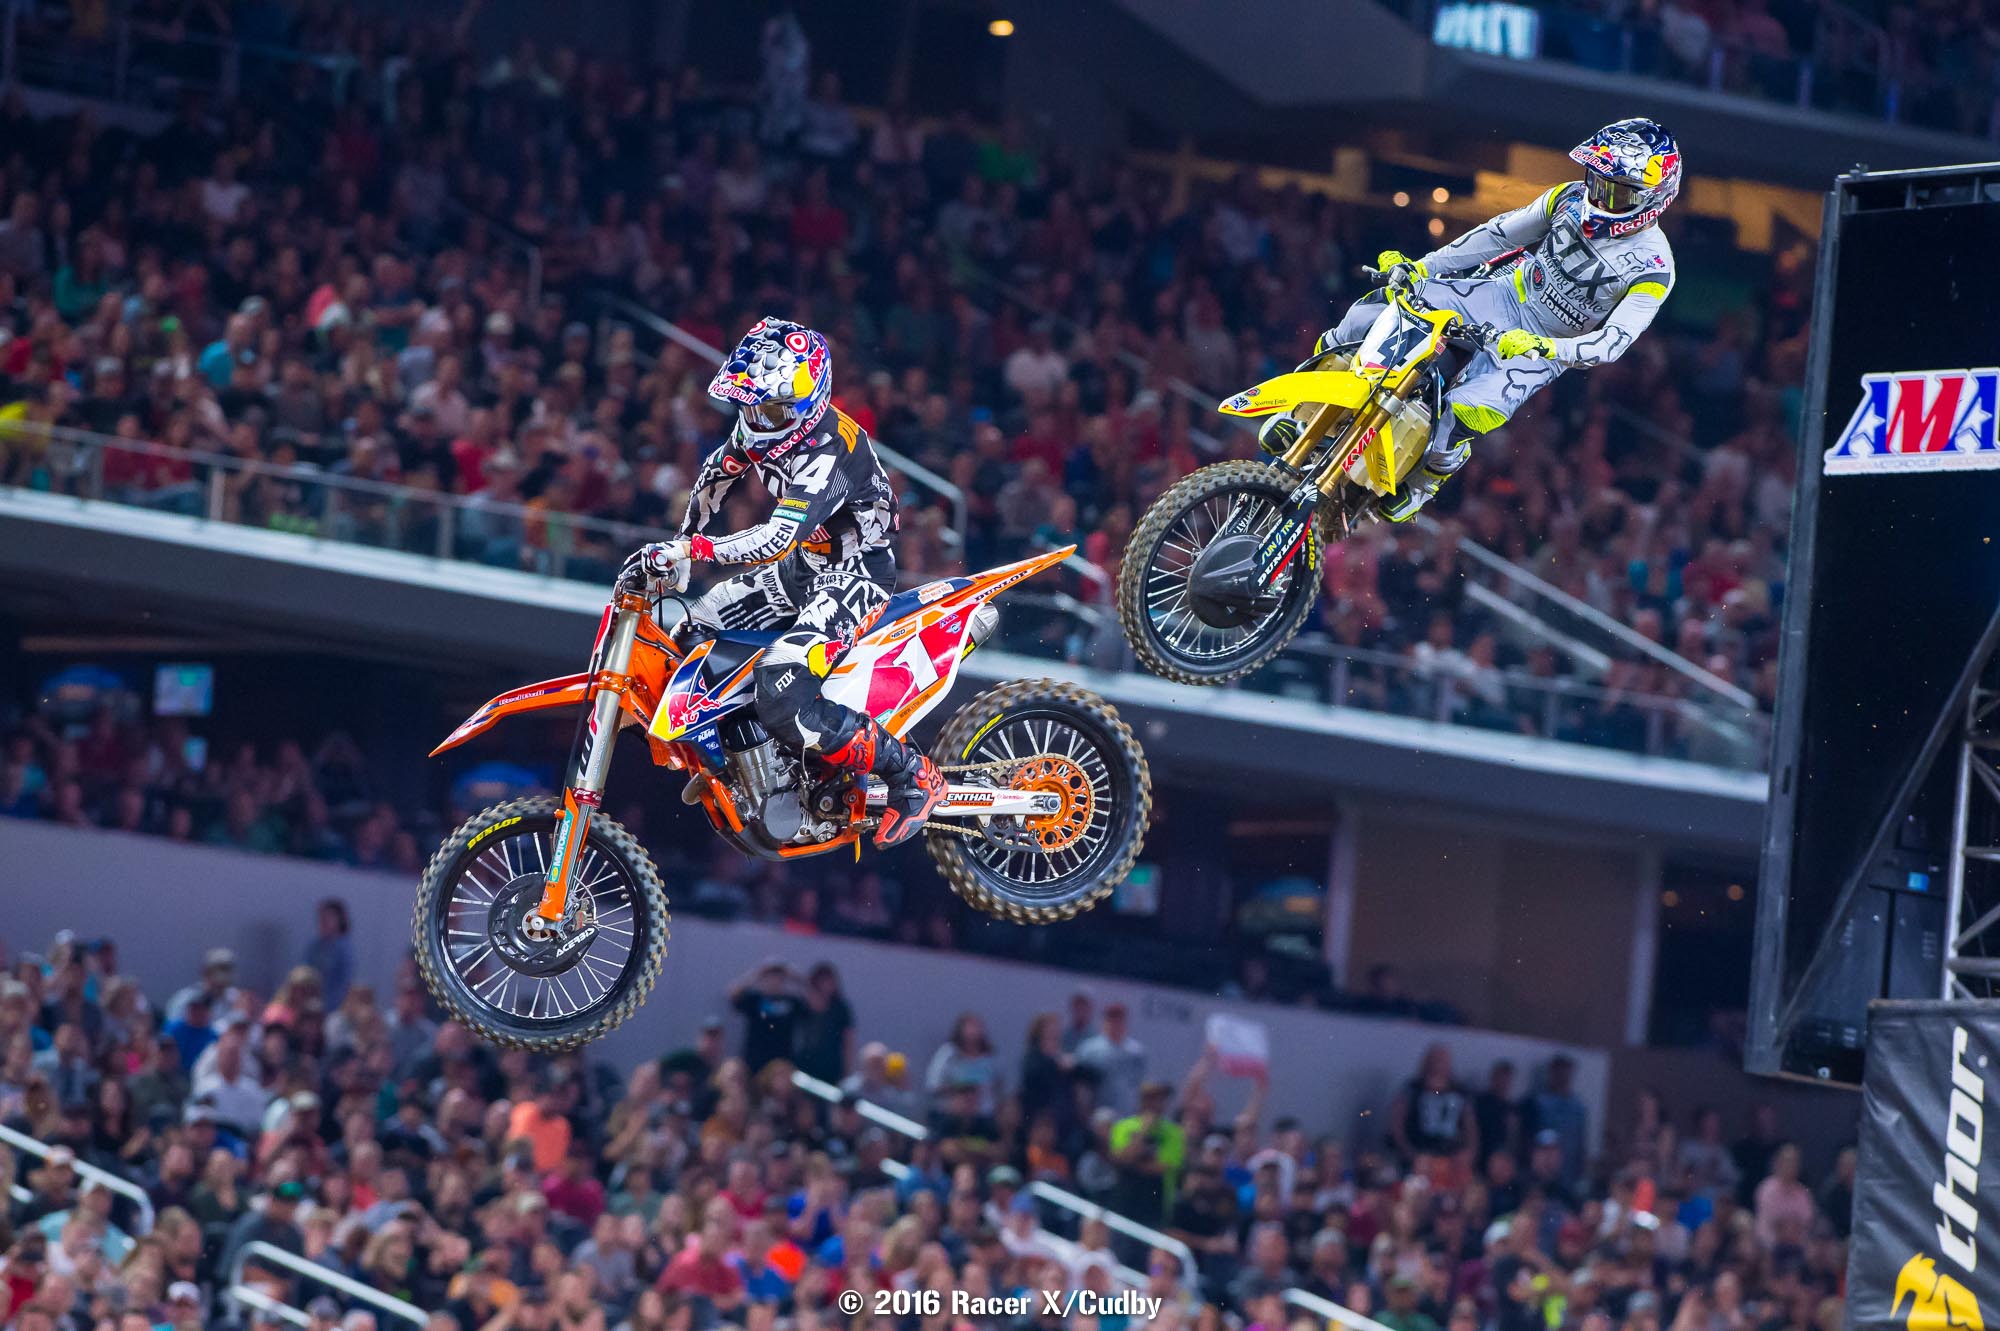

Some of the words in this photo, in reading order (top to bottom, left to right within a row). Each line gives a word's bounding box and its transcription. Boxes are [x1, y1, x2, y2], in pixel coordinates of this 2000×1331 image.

[1610, 212, 1645, 237] Red
[1540, 294, 1585, 332] JOHN'S
[1545, 282, 1590, 324] JIMMY
[1563, 281, 1609, 313] Eagle
[1377, 327, 1429, 368] 4
[710, 382, 732, 397] Red
[731, 387, 757, 406] Bull
[1825, 369, 2000, 458] AMA
[767, 430, 804, 461] Red
[801, 399, 828, 437] Bull
[740, 522, 795, 564] SIXTEEN
[1257, 522, 1305, 587] DUNLOP
[973, 570, 1031, 603] DUNLOP
[774, 668, 797, 693] FOX
[893, 634, 940, 693] 1
[698, 728, 716, 743] KTM
[467, 815, 523, 851] DUNLOP
[552, 818, 572, 867] MOTOREX
[555, 927, 597, 958] ACERBIS
[1932, 1025, 1985, 1274] thor
